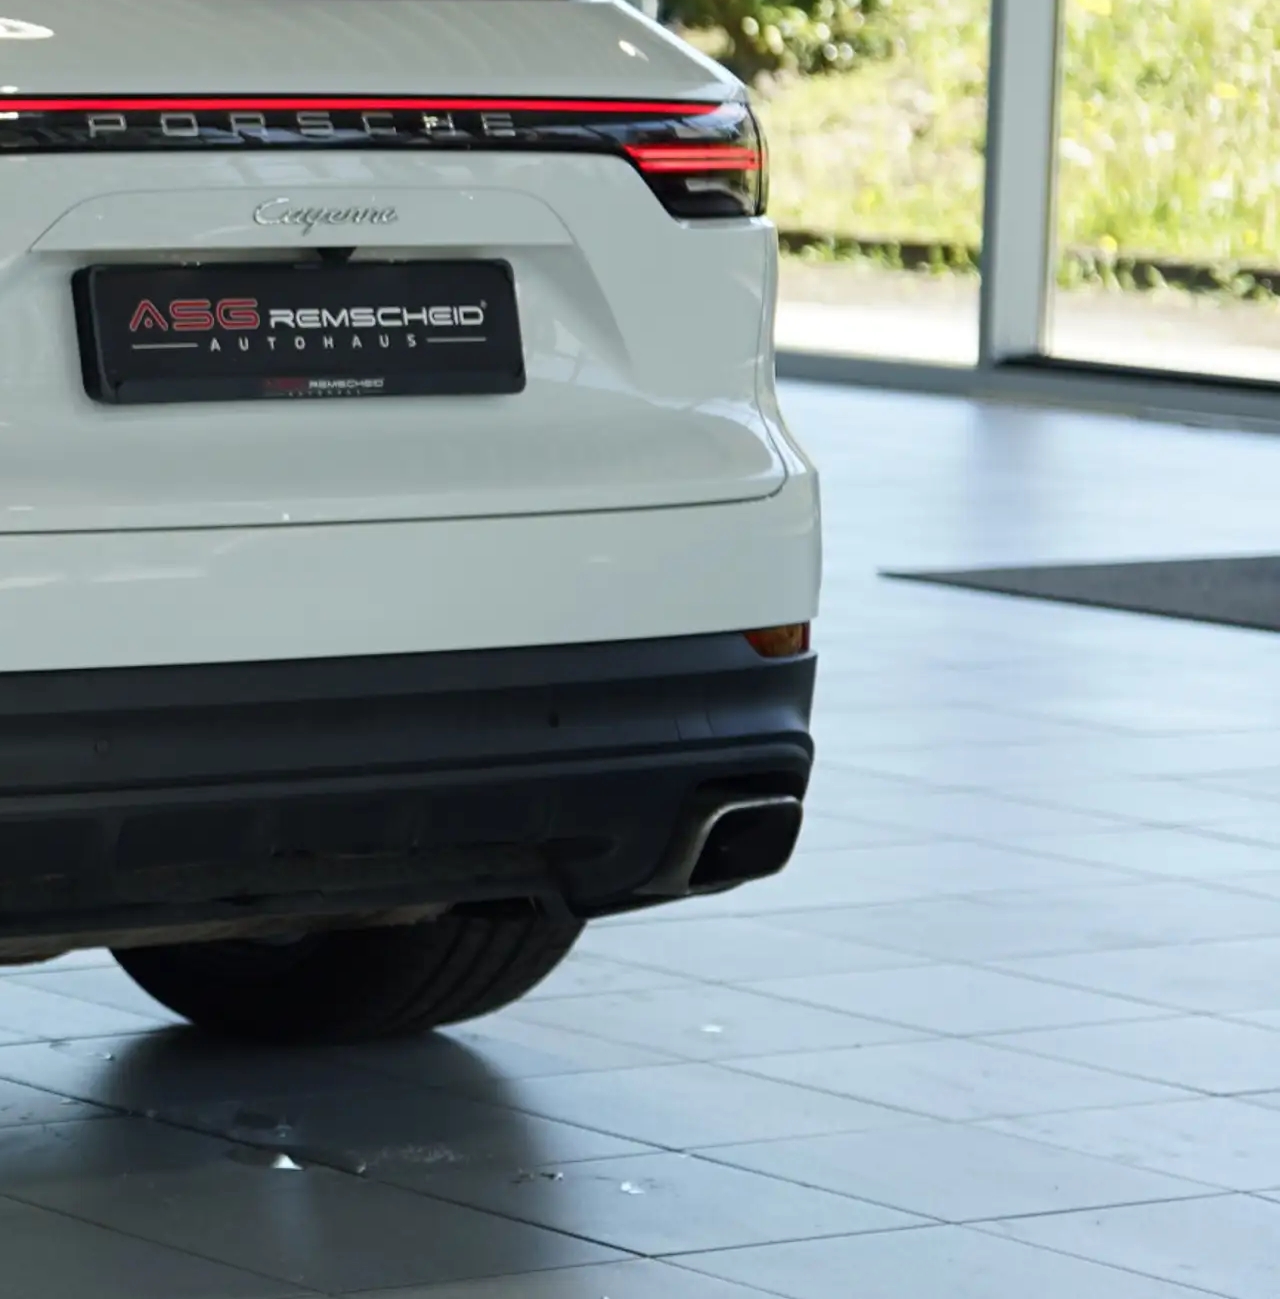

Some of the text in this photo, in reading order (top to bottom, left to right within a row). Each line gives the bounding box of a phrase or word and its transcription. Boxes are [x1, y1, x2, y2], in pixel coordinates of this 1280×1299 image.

[88, 111, 516, 137] PORSCHE
[253, 197, 398, 237] Cayenne
[129, 298, 484, 332] ASG REMSCHEID
[210, 333, 417, 352] AUTOHAUS
